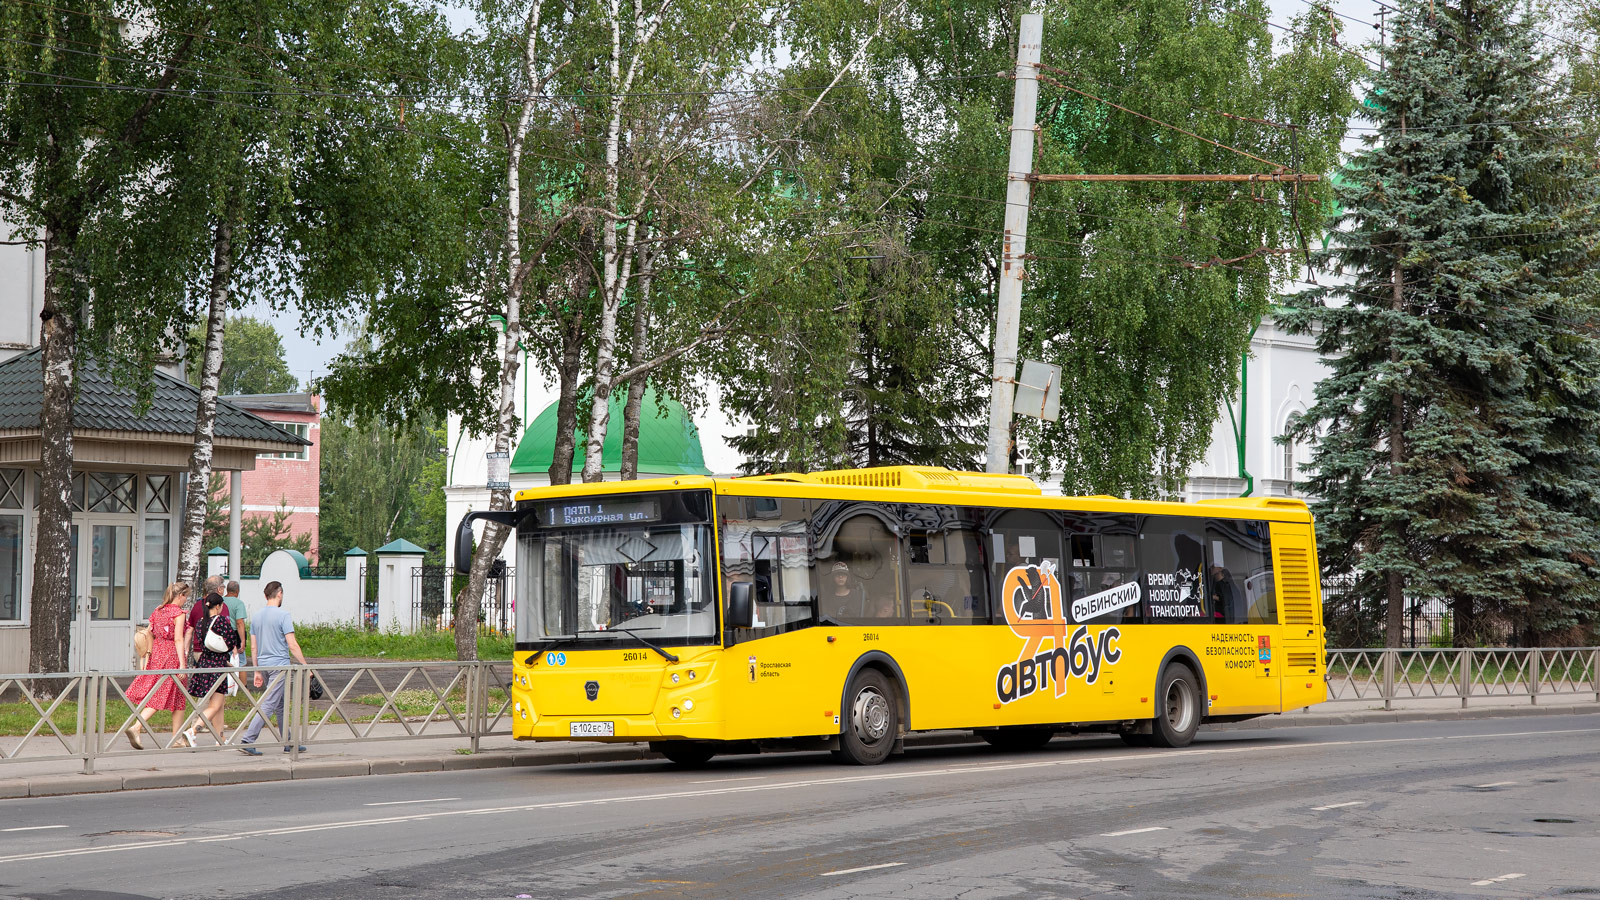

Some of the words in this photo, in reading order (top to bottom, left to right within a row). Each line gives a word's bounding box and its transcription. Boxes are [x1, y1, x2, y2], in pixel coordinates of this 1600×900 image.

[550, 507, 556, 525] 1
[564, 505, 590, 516] ПАТП
[597, 504, 603, 514] 1
[564, 513, 624, 525] Буксирная
[629, 512, 649, 520] ул.
[1148, 573, 1174, 586] ВРЕМЯ
[1074, 582, 1138, 619] РЫБИНСКИЙ
[1149, 589, 1180, 602] НОВОГО
[1150, 605, 1201, 617] ТРАНСПОРТА
[863, 633, 879, 641] 26014
[1211, 633, 1255, 643] НАДЕЖНОСТЬ
[623, 652, 647, 661] 26014
[1206, 647, 1255, 656] БЕЗОПАСНОСТЬ
[997, 624, 1122, 703] автобус
[1225, 660, 1255, 669] КОМФОРТ
